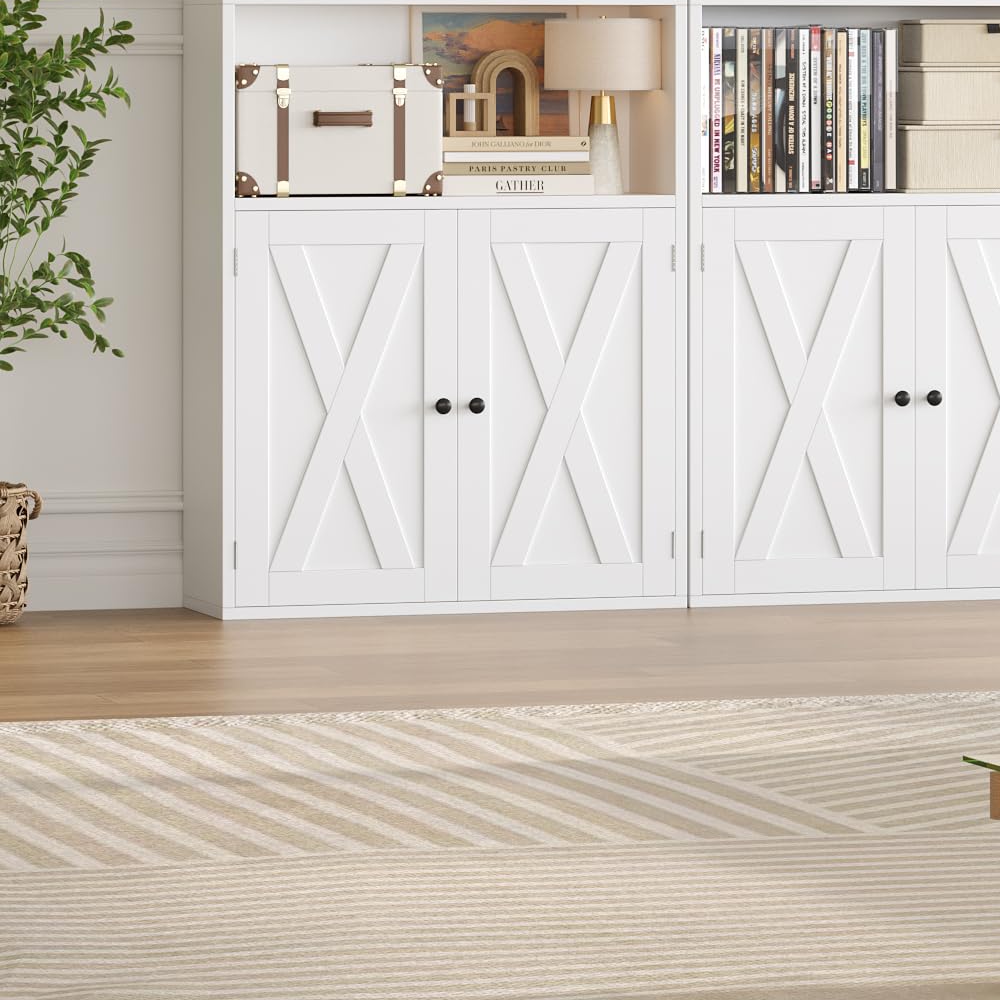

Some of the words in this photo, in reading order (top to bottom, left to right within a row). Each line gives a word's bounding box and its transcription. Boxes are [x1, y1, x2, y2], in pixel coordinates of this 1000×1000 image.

[714, 129, 721, 137] IN
[788, 126, 795, 134] OF
[496, 180, 545, 191] GATHER
